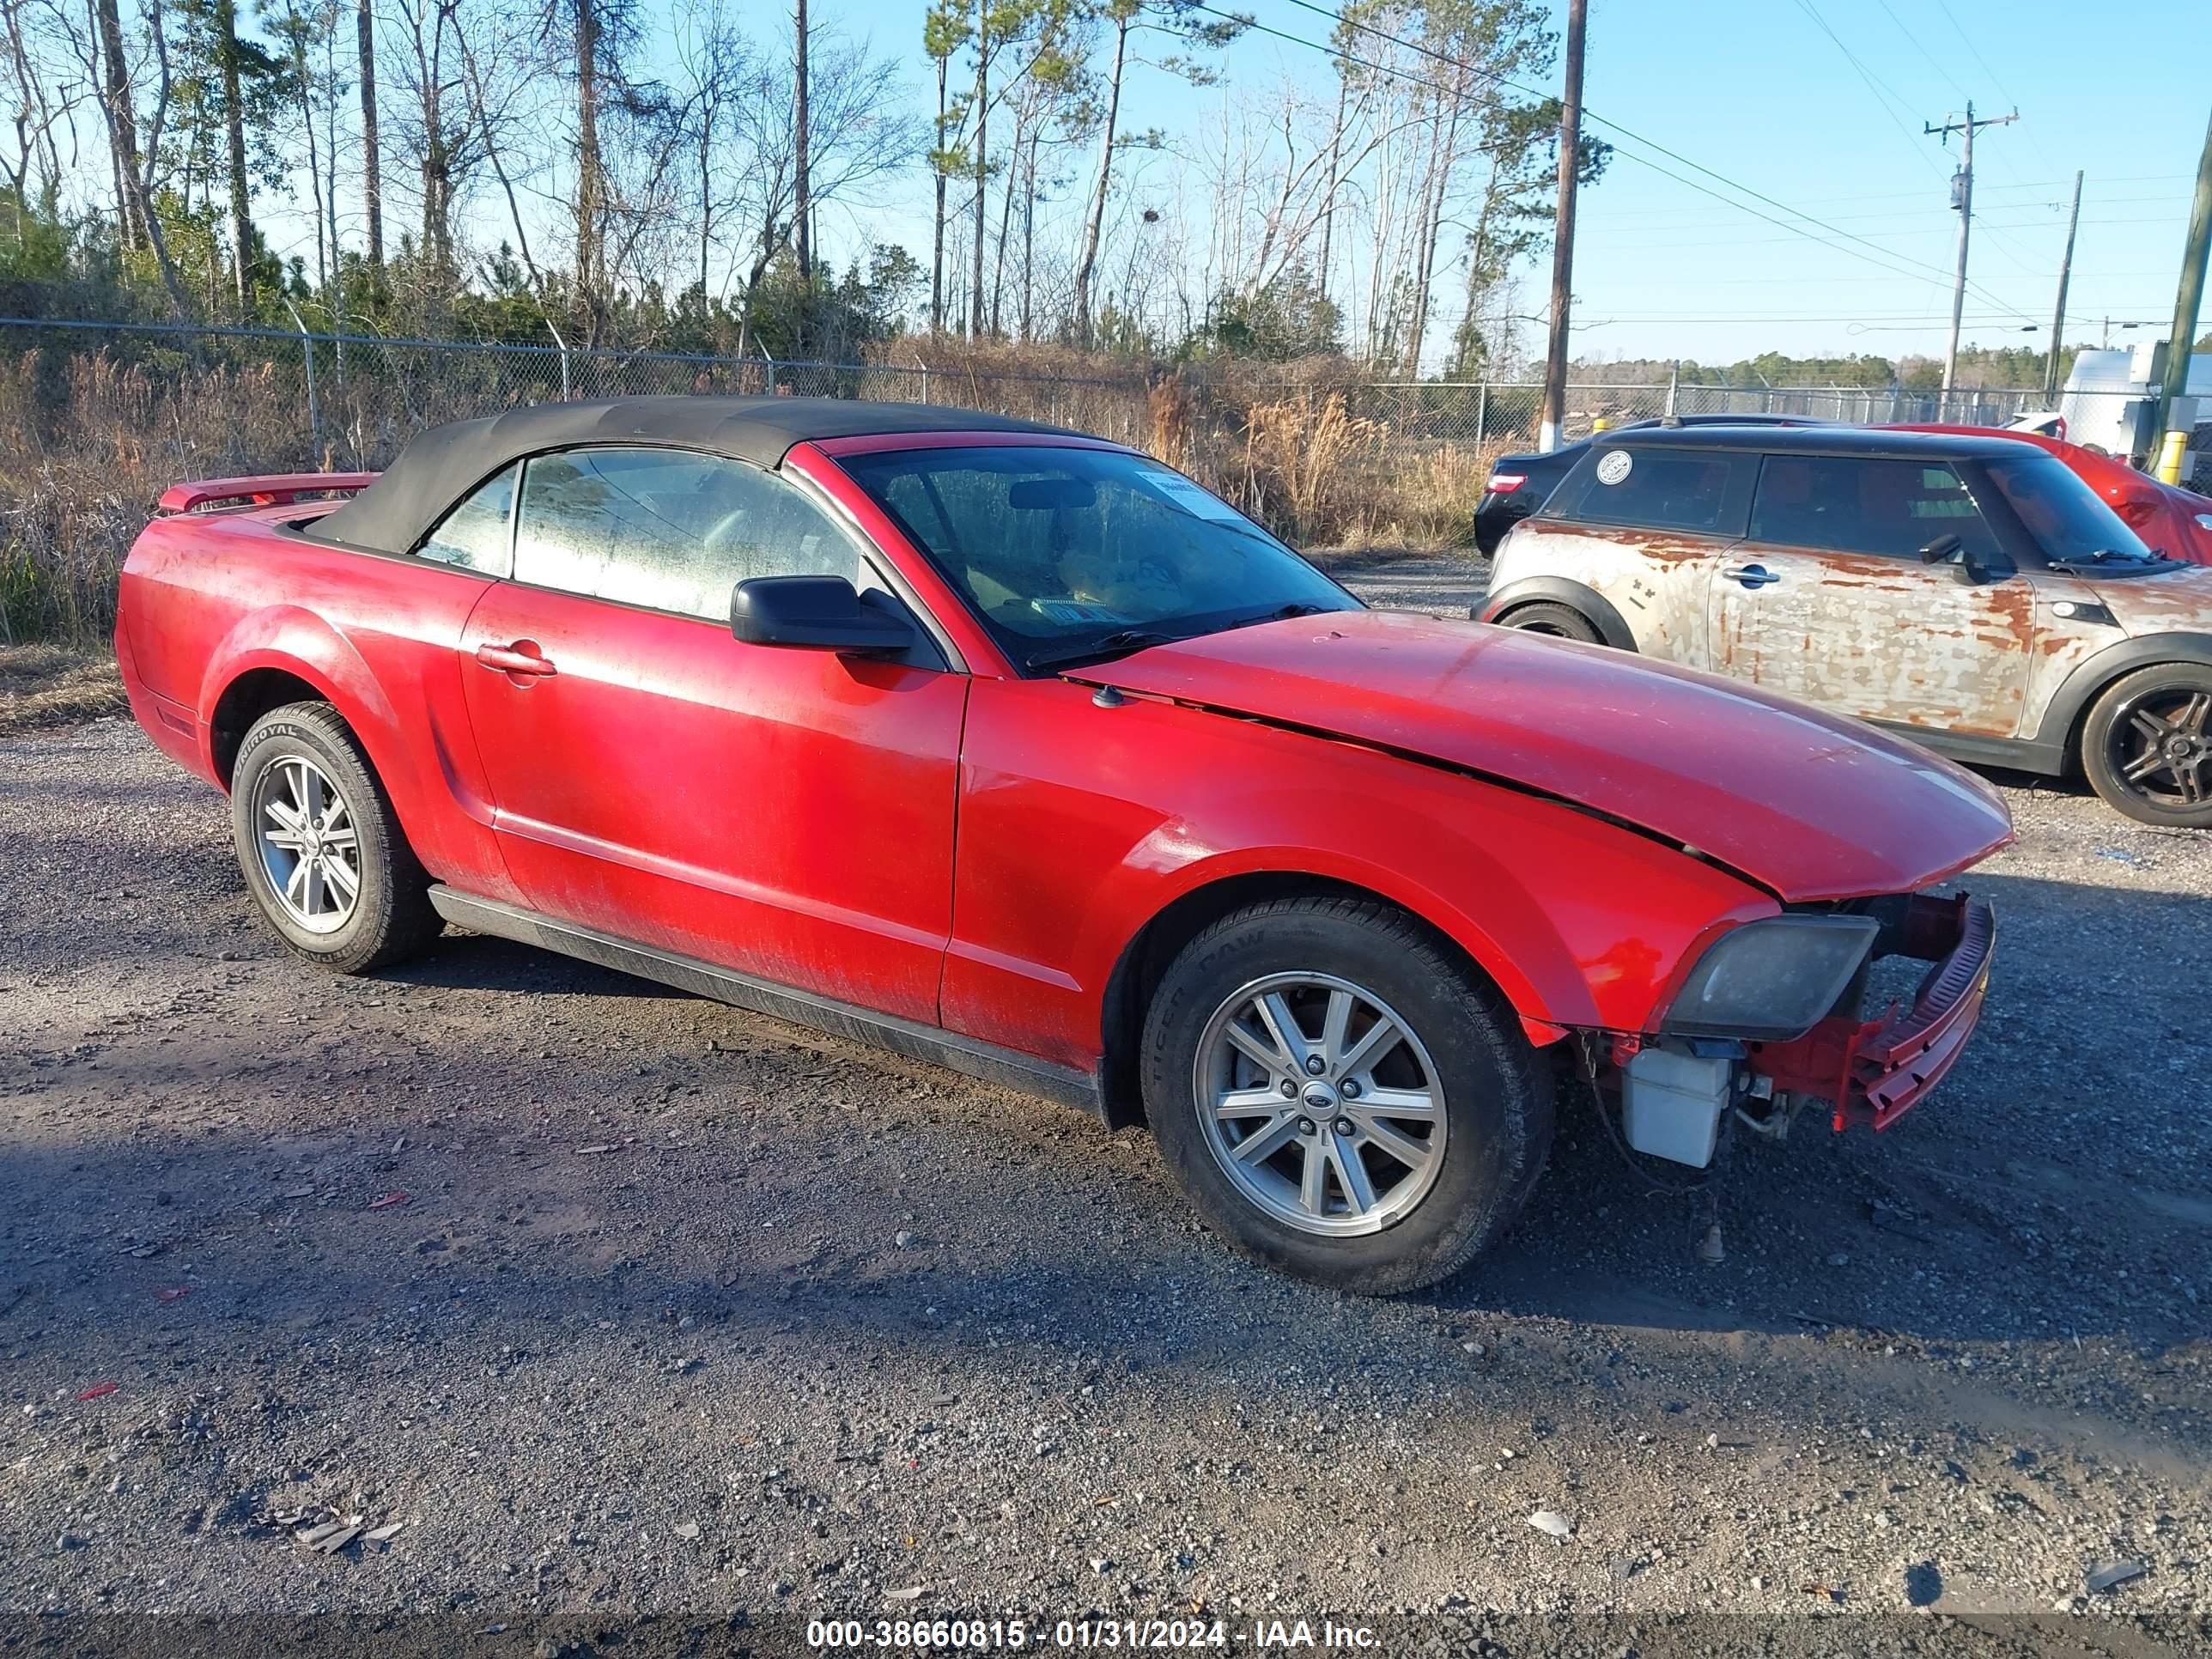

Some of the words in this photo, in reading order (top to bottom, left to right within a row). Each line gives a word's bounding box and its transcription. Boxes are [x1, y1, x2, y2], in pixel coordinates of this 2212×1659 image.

[235, 726, 298, 778] UNIROYAL
[1152, 987, 1187, 1086] TIGER
[1200, 929, 1265, 972] PAW
